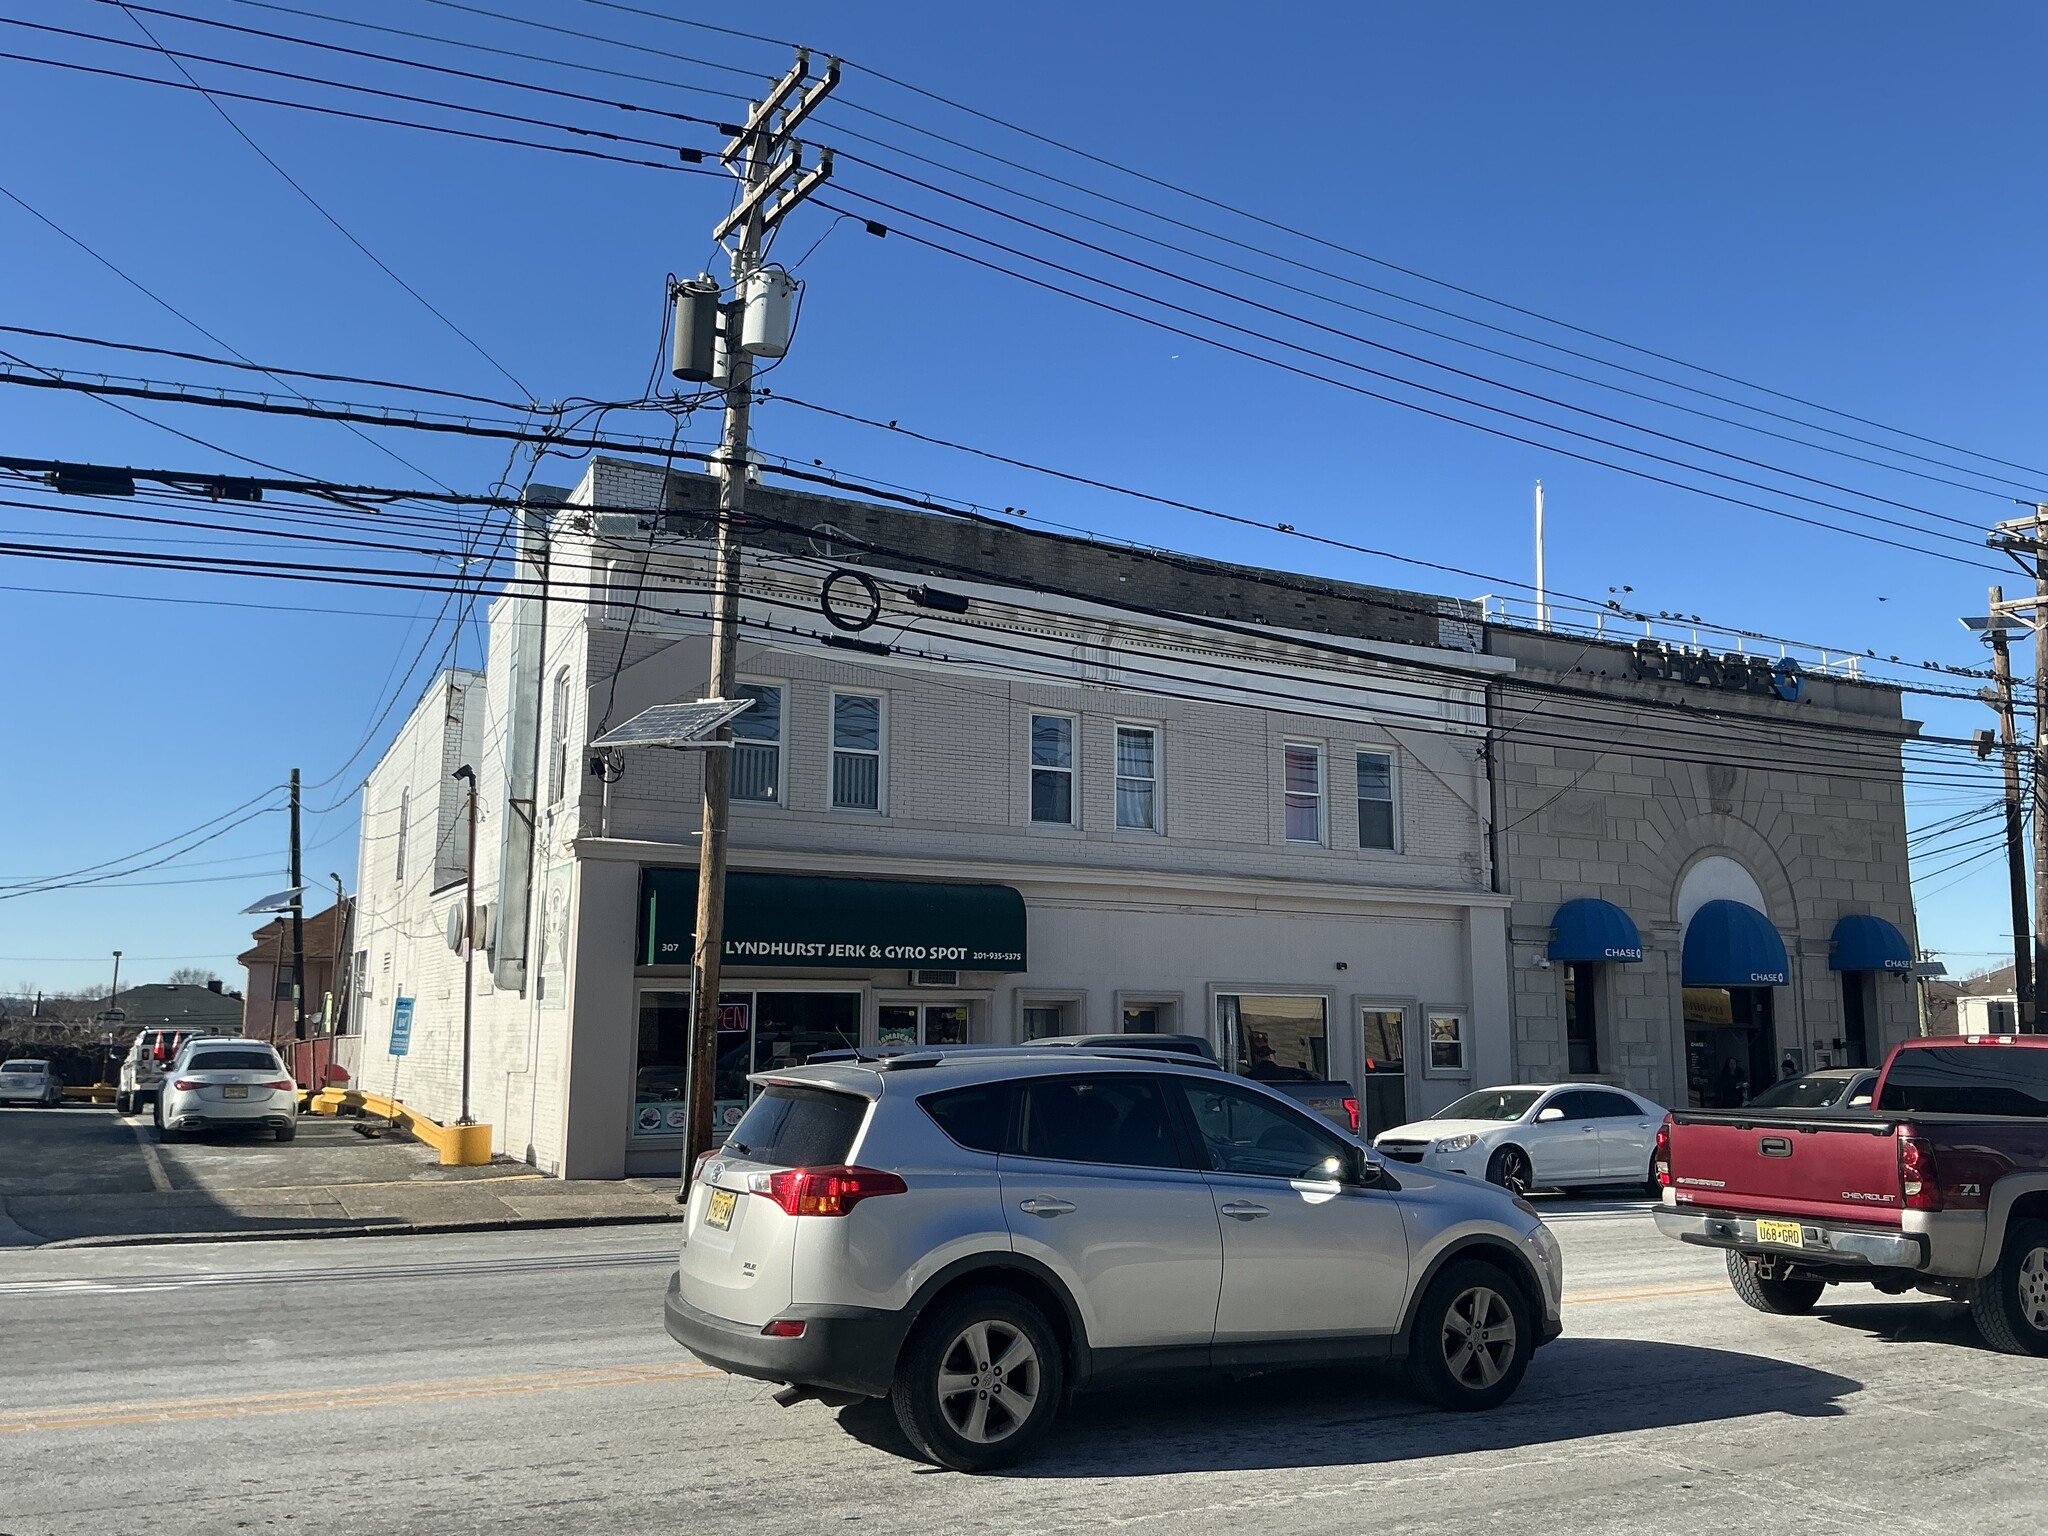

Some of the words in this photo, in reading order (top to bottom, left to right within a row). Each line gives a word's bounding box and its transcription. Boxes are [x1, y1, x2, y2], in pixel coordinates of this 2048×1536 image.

[1632, 639, 1772, 695] CHASE
[661, 943, 679, 952] 307
[725, 941, 826, 957] LYNDHURST
[827, 944, 866, 958] JERK
[869, 945, 882, 959] &
[884, 945, 927, 959] GYRO
[929, 947, 968, 960] SPOT
[973, 952, 1022, 961] 201-935-5375
[1604, 948, 1636, 957] CHASE
[1884, 959, 1910, 968] CHASE
[1750, 973, 1778, 982] CHASE
[717, 1006, 746, 1030] PEN
[1842, 1191, 1896, 1203] CHEVROLET
